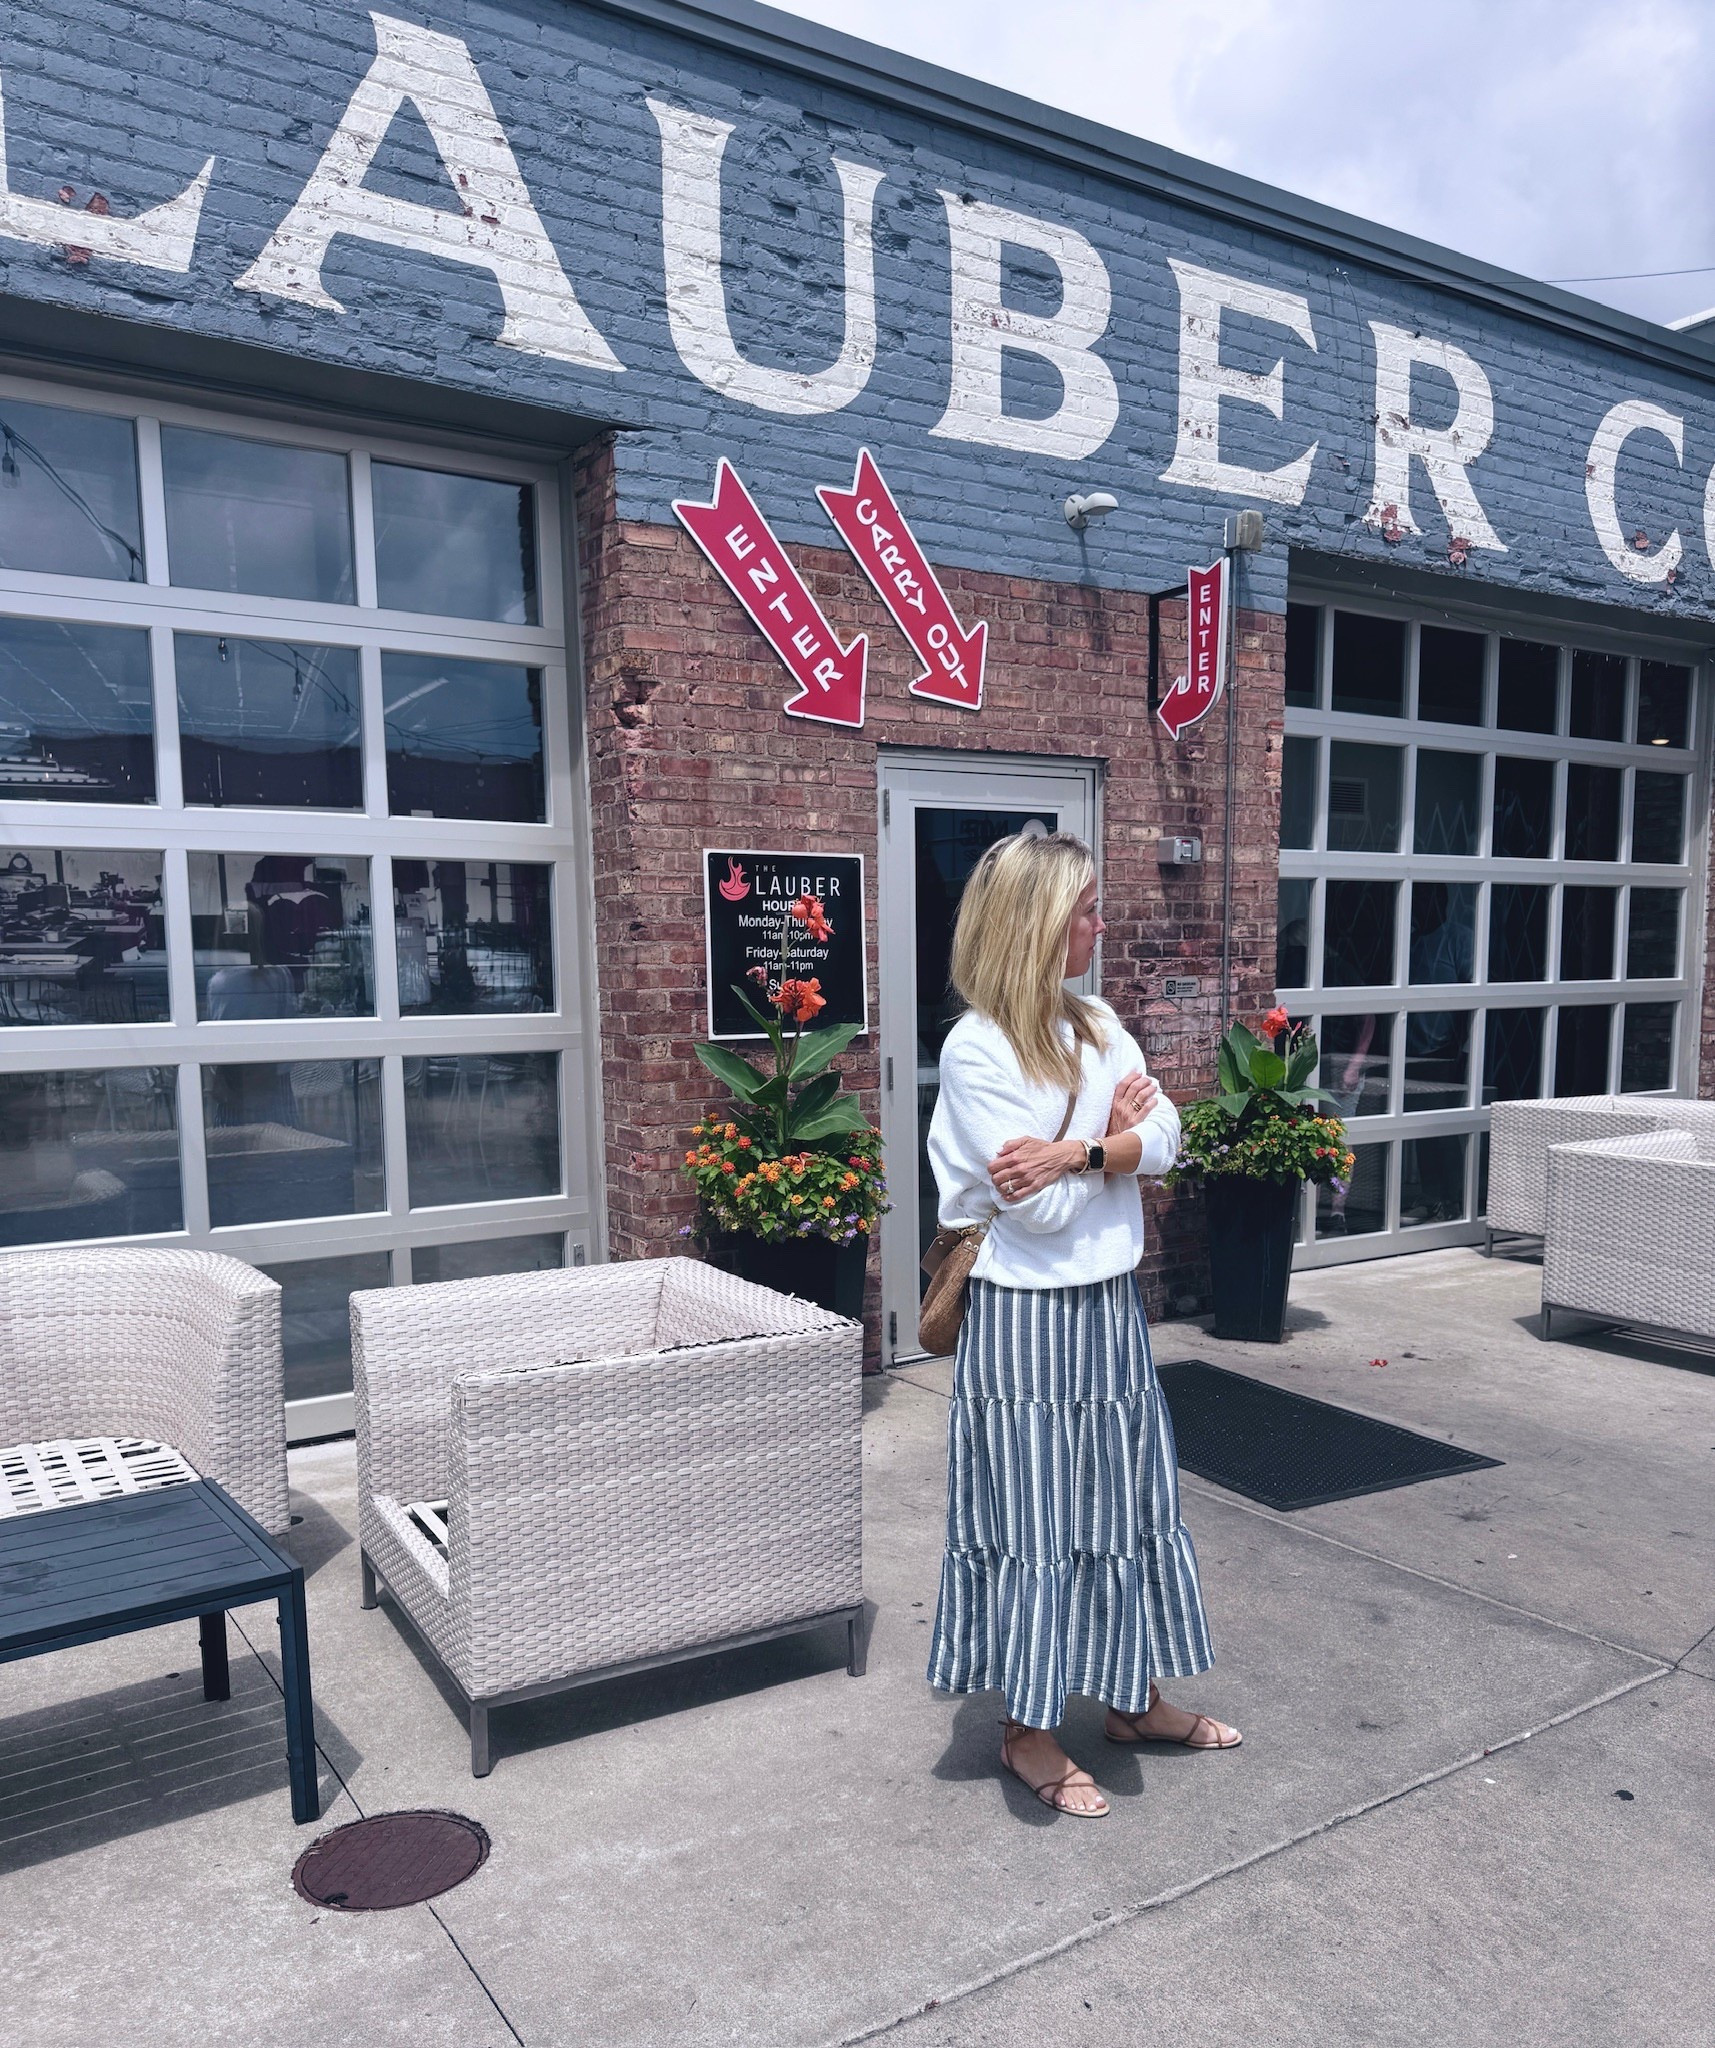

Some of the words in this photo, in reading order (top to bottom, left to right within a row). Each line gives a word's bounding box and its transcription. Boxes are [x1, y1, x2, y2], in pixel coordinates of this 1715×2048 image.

[1585, 400, 1715, 583] C
[724, 523, 844, 692] ENTER
[855, 498, 927, 615] CARRY
[926, 623, 969, 689] OUT
[1197, 584, 1211, 694] ENTER
[755, 864, 777, 873] THE
[755, 875, 841, 897] LAUBER
[762, 900, 799, 911] HOUR
